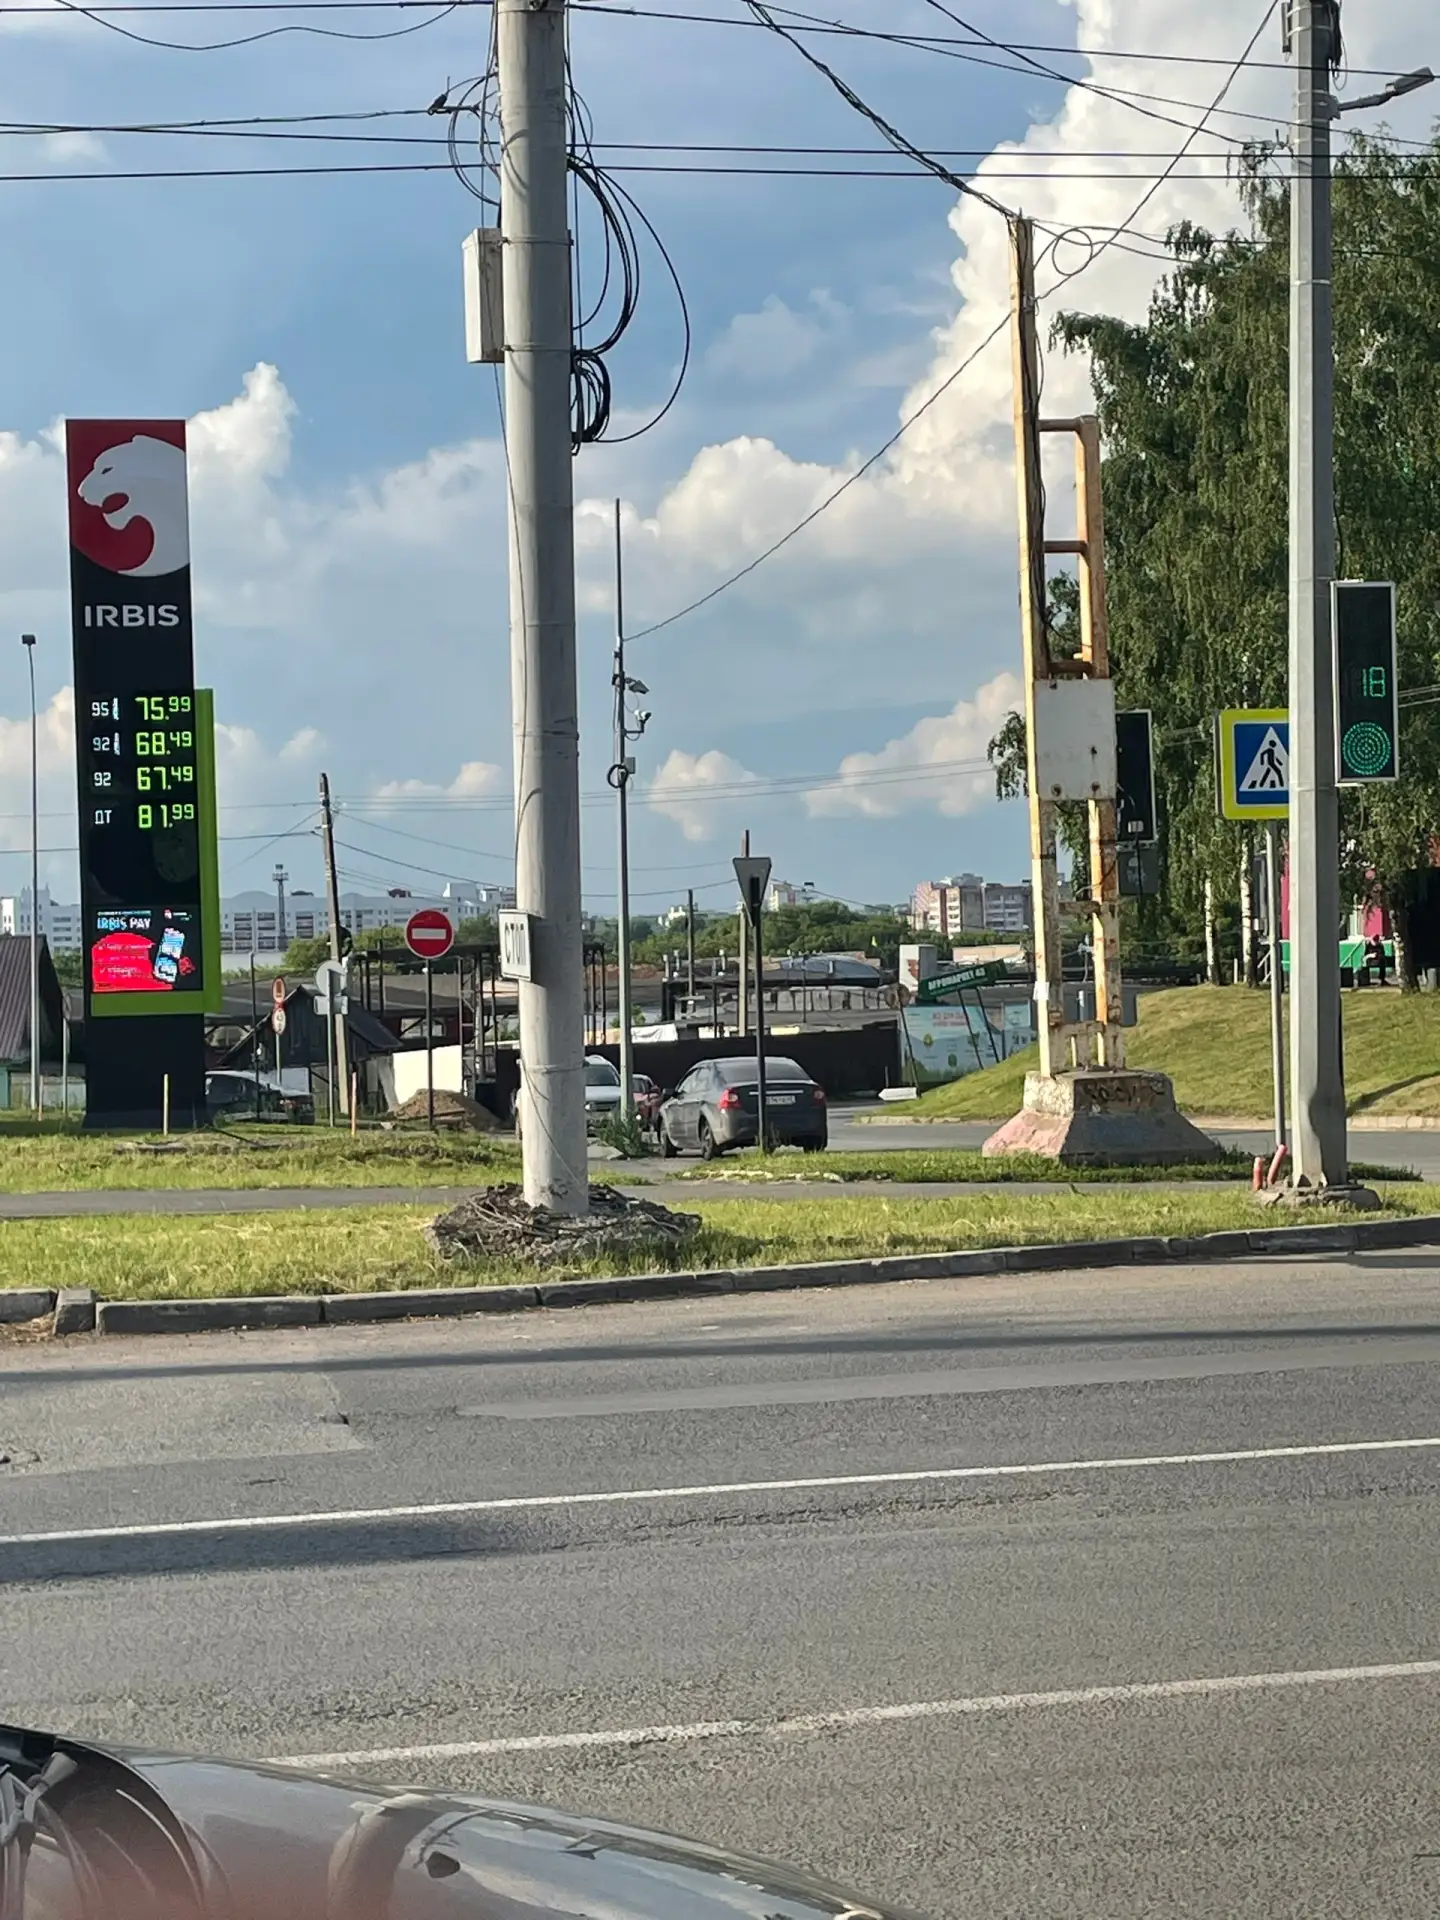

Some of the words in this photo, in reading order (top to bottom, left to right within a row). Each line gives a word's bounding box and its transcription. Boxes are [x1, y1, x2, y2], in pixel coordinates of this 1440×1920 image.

[84, 604, 180, 628] IRBIS
[1362, 666, 1386, 698] 18
[91, 702, 110, 717] 95
[92, 737, 110, 751] 92
[135, 731, 193, 756] 68.49
[93, 772, 111, 787] 92
[136, 766, 194, 790] 67.49
[138, 803, 195, 829] 81.99
